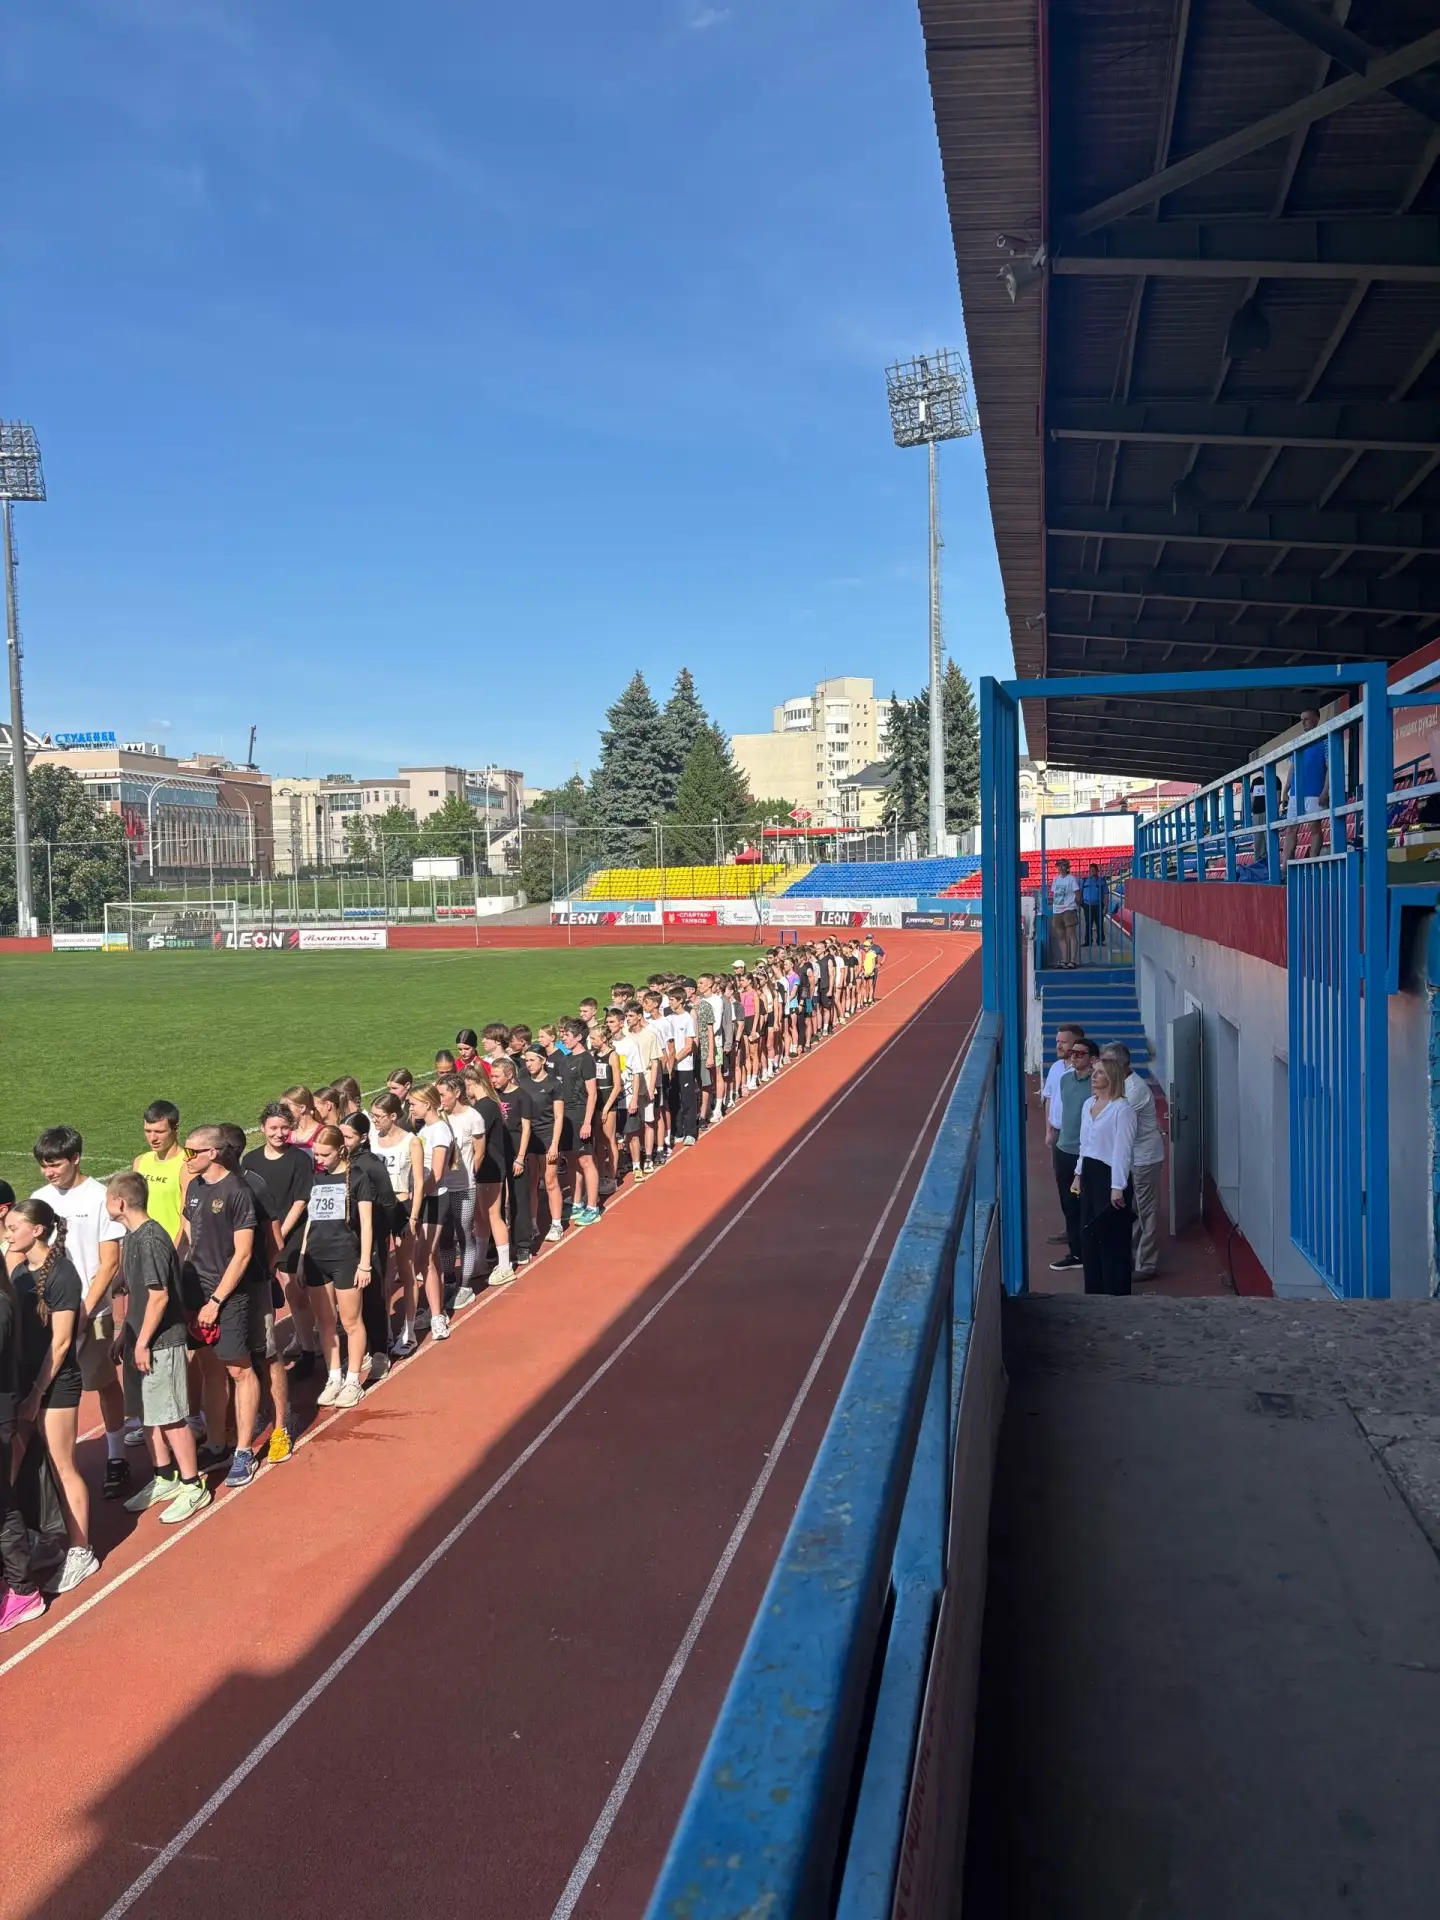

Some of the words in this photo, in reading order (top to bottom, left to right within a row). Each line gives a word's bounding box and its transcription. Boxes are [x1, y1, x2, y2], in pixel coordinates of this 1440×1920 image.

[559, 913, 598, 925] LEON
[821, 912, 850, 925] LEON
[970, 919, 982, 927] LEO
[147, 935, 165, 949] 15
[226, 932, 285, 948] LEON
[144, 1174, 168, 1184] ELME
[315, 1198, 334, 1211] 736
